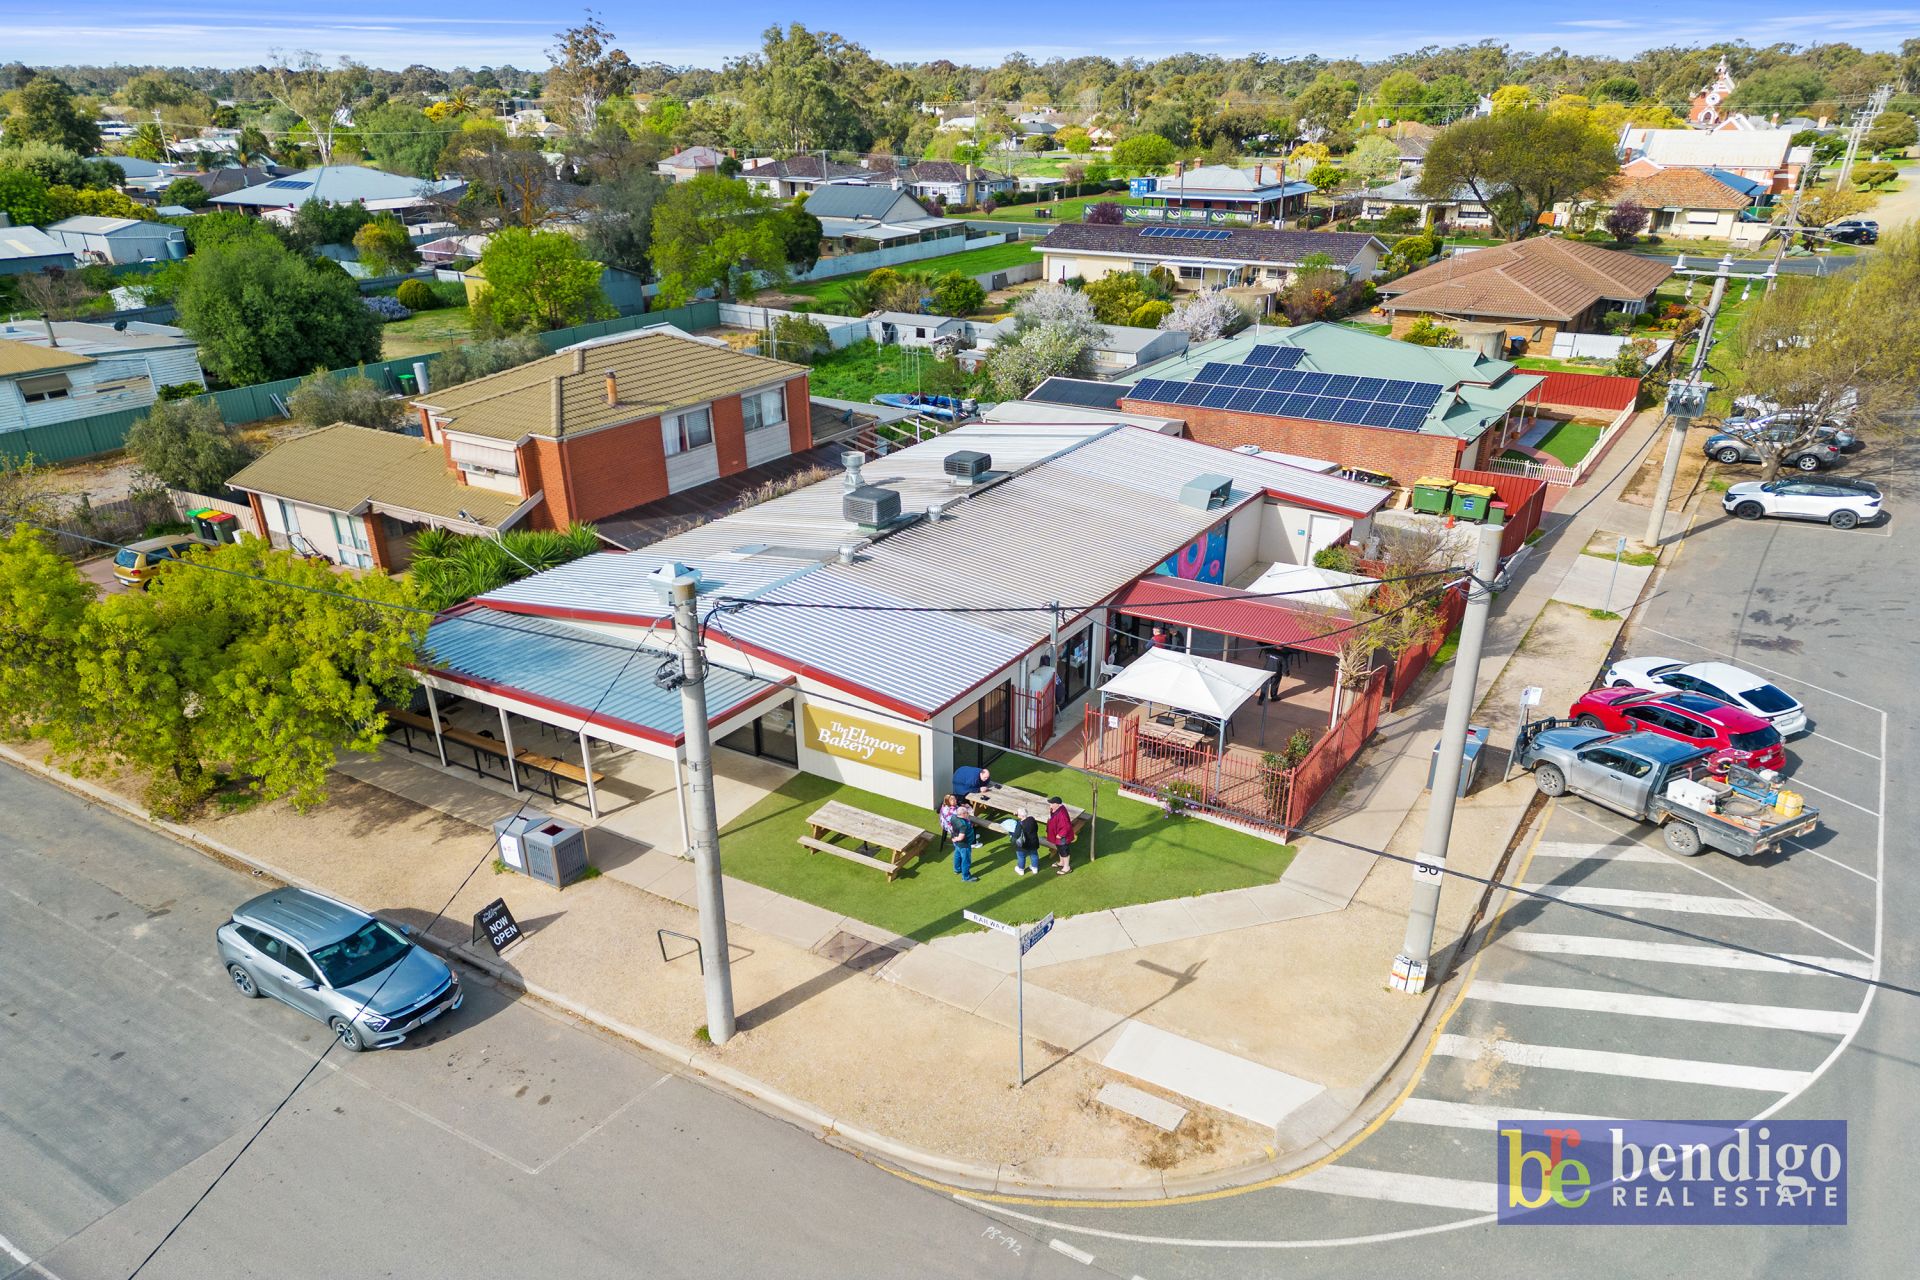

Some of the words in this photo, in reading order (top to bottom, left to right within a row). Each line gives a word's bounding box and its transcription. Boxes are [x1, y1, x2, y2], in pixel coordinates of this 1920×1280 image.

[817, 727, 875, 760] Bakery
[830, 721, 849, 734] The
[847, 726, 906, 755] Elmore
[489, 915, 509, 934] NOW
[973, 914, 1006, 930] RAILWAY
[493, 924, 518, 945] OPEN
